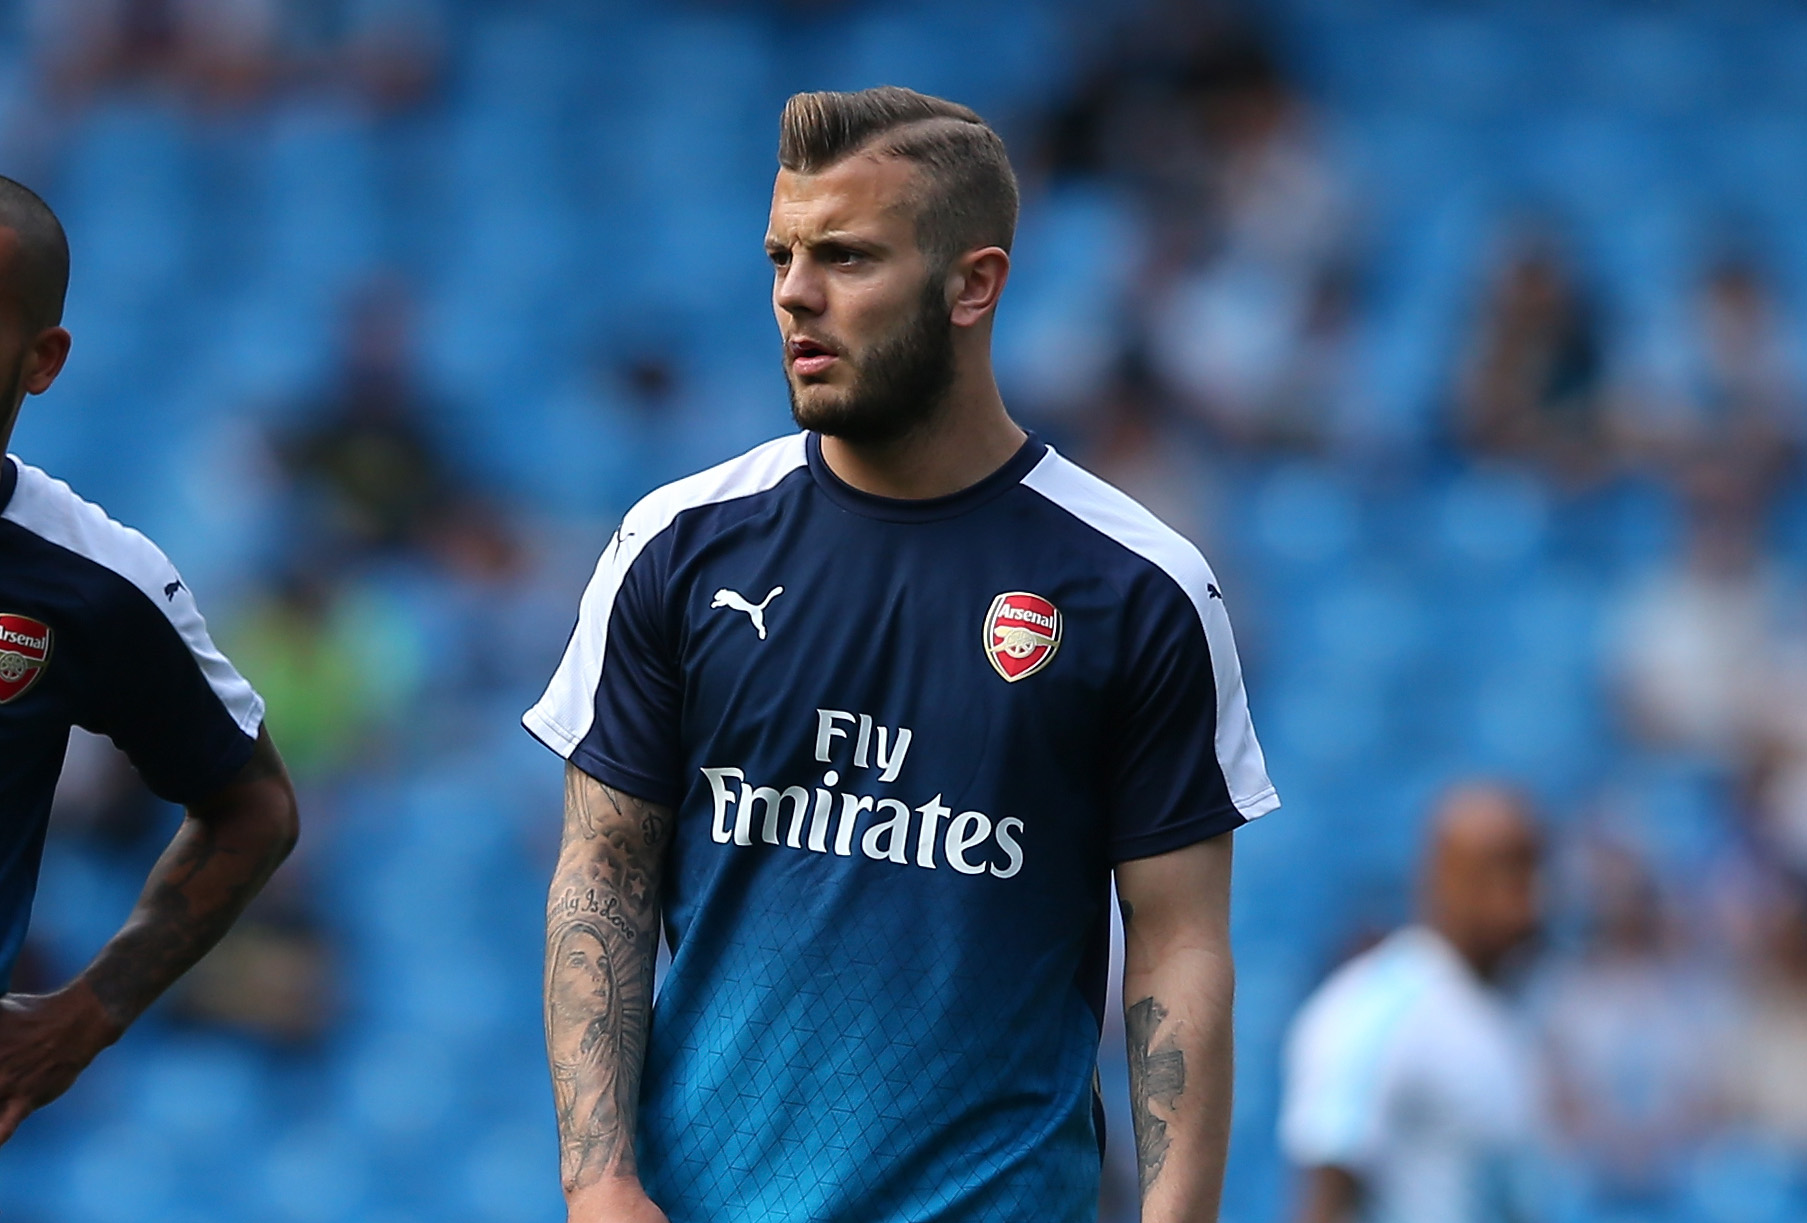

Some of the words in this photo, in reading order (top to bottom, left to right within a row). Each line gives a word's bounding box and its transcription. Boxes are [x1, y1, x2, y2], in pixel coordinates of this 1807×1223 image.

[998, 603, 1054, 629] Arsenal
[815, 708, 913, 783] Fly
[699, 766, 1025, 879] Emirates
[599, 897, 635, 940] Love
